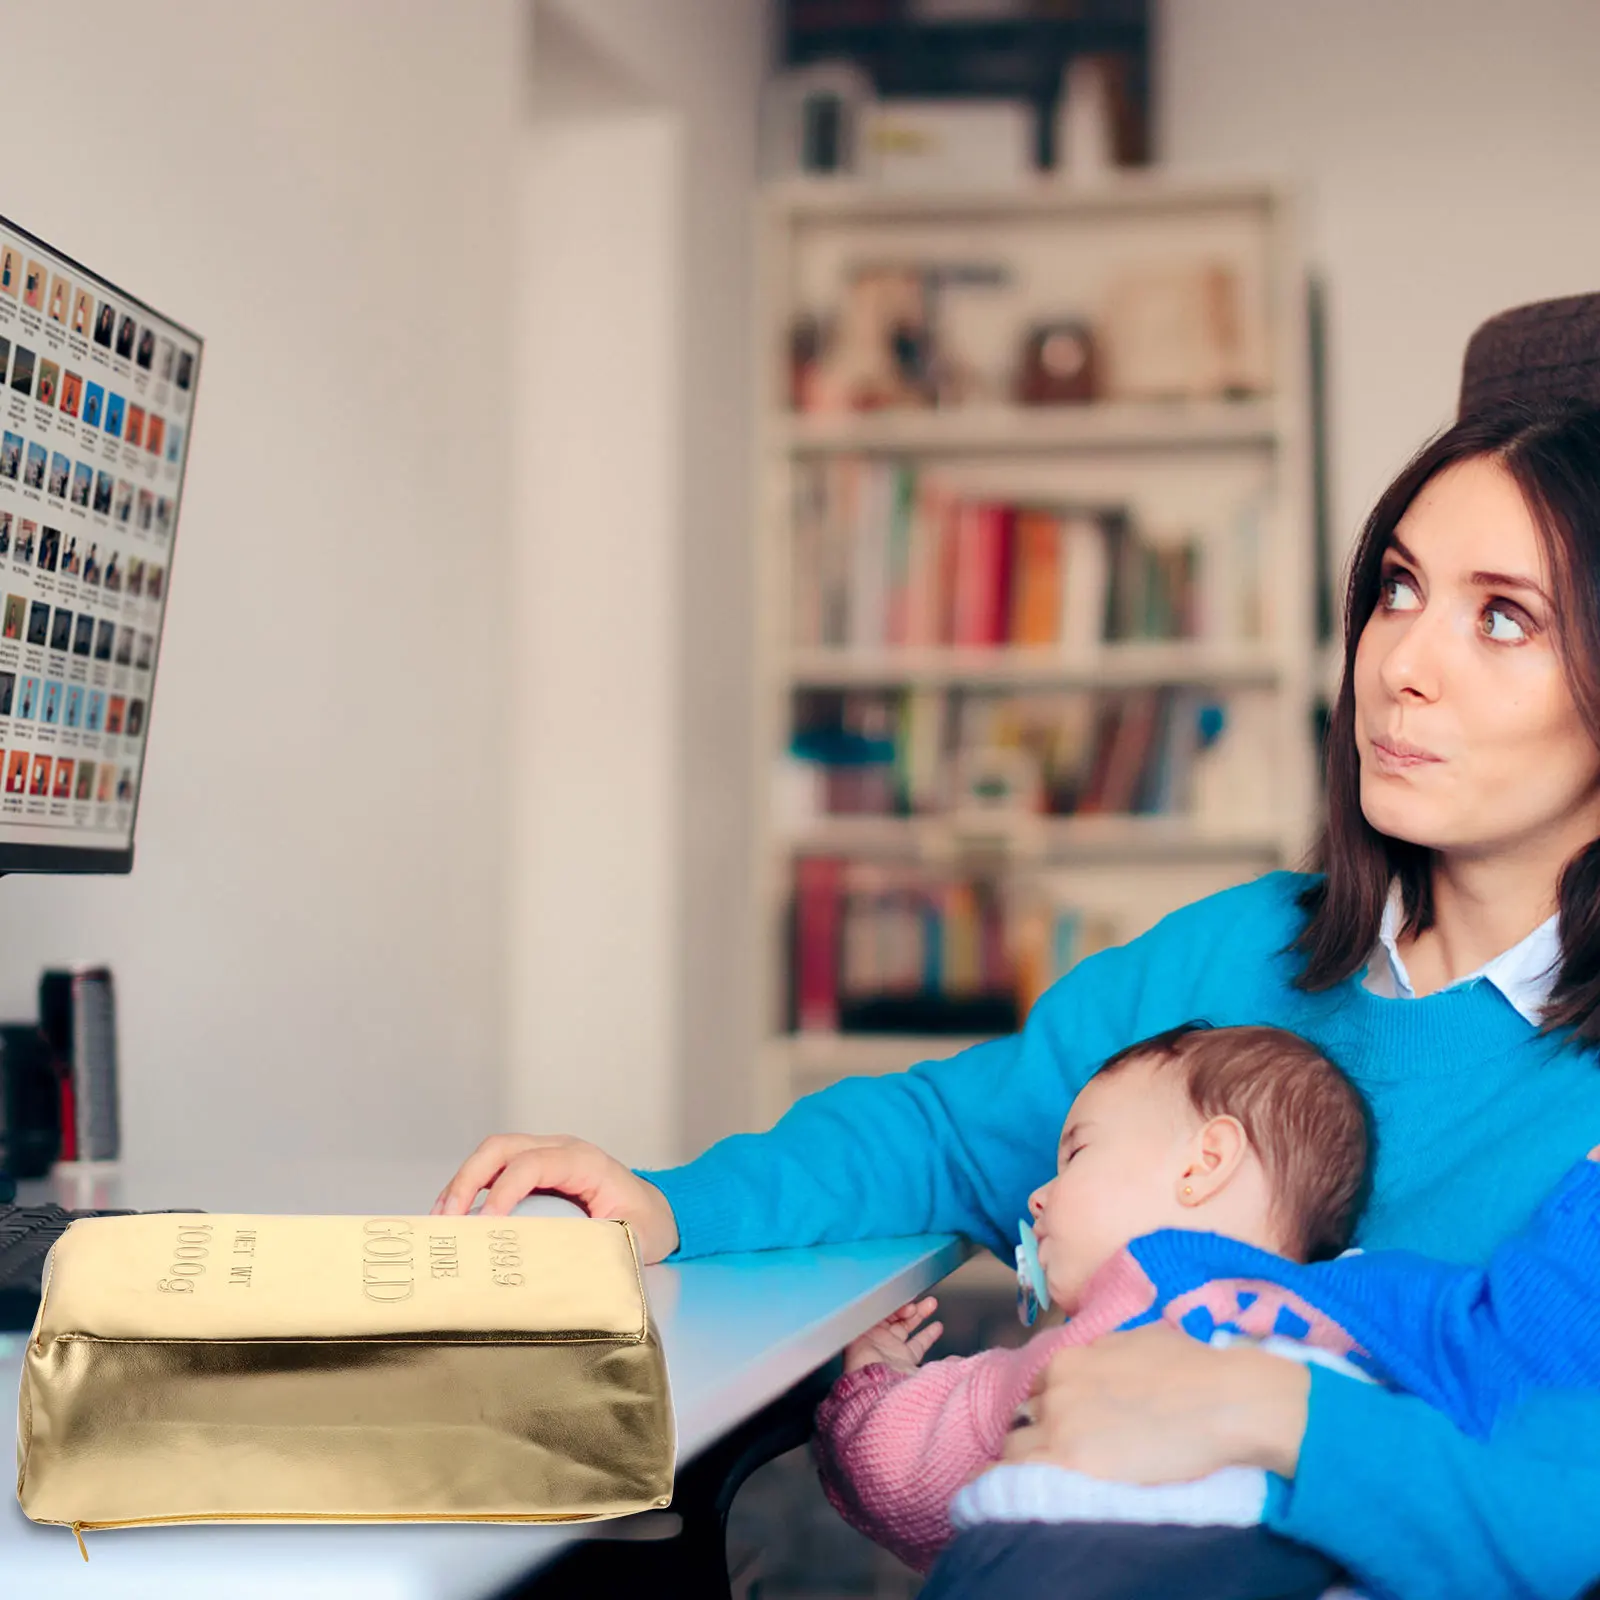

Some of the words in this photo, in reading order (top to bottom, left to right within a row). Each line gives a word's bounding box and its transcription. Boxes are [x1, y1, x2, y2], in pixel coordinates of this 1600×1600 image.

[157, 1224, 214, 1294] 1000g
[233, 1230, 257, 1257] NET
[363, 1218, 415, 1303] GOLD
[429, 1235, 459, 1279] FINE
[487, 1229, 526, 1287] 999.9
[228, 1265, 253, 1288] WT
